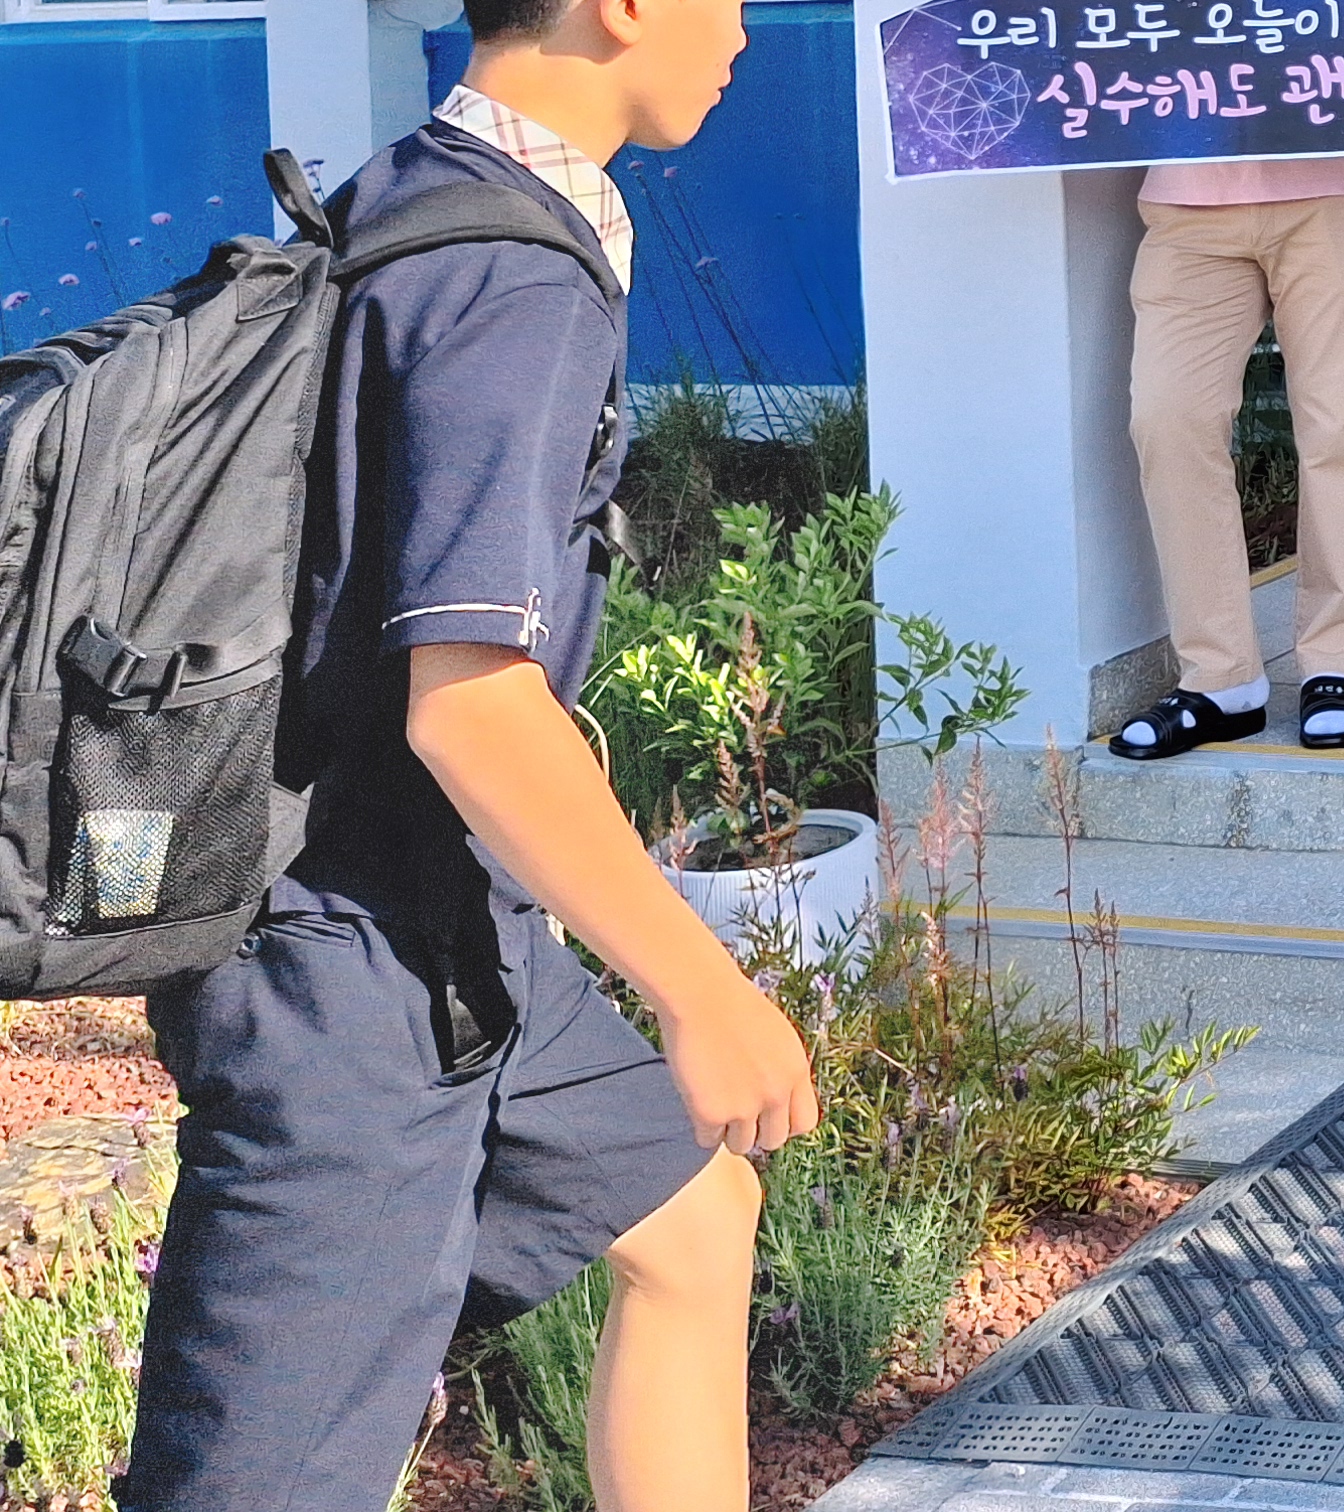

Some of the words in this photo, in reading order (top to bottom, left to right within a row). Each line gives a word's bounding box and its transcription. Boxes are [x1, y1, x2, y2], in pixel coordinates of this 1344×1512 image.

[957, 7, 1057, 59] 우리
[1076, 3, 1180, 52] 모두
[1036, 61, 1267, 138] 실수해도
